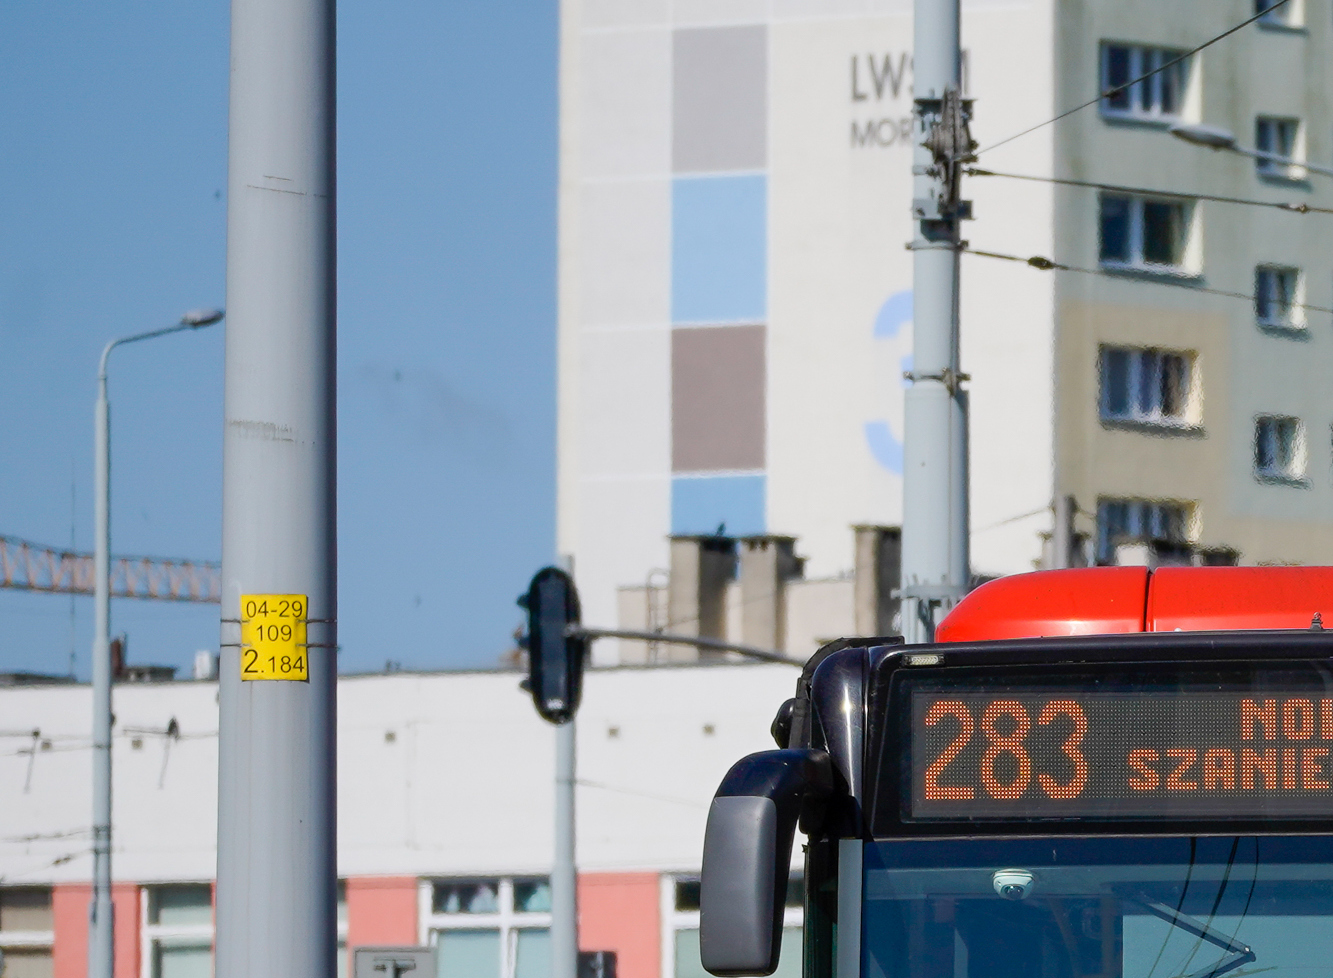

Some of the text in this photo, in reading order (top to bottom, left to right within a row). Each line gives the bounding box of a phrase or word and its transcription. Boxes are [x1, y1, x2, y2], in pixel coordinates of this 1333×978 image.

[850, 50, 969, 101] LW
[246, 600, 303, 618] 04-29
[256, 624, 292, 642] 109
[243, 649, 304, 674] 2.184
[925, 700, 1088, 800] 283
